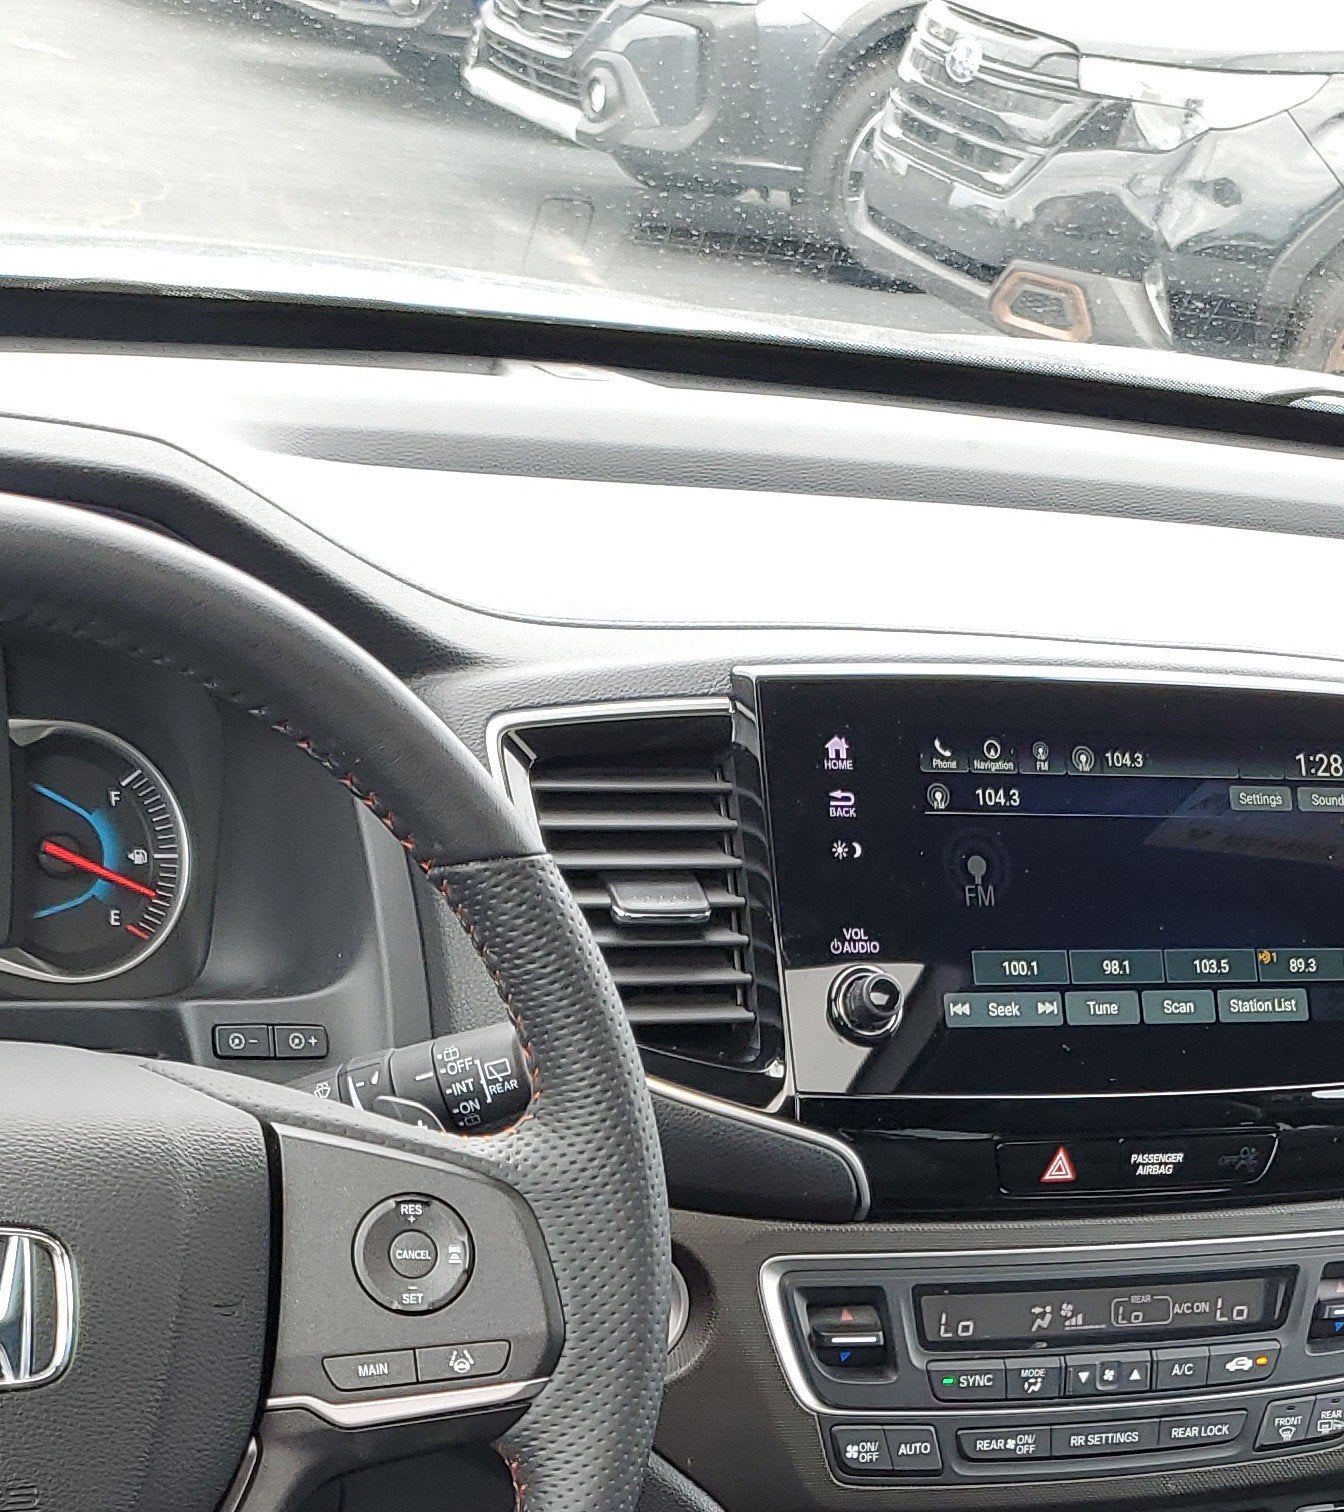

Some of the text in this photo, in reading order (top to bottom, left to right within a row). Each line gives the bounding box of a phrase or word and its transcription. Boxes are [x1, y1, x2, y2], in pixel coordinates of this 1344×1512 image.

[824, 760, 853, 771] HOME
[932, 758, 957, 769] Phone
[974, 759, 1014, 771] Navigation
[1037, 761, 1048, 771] FM
[1105, 752, 1144, 768] 104.3
[1295, 753, 1344, 777] 1:28
[110, 791, 121, 807] F
[976, 788, 1020, 806] 104.3
[1239, 791, 1283, 808] Settings
[1311, 794, 1344, 806] Sound
[829, 807, 856, 818] BACK
[965, 885, 995, 907] FM
[110, 910, 121, 926] E
[843, 928, 868, 940] VOL
[843, 941, 880, 953] AUDIO
[1002, 961, 1038, 976] 100.1
[1102, 960, 1130, 975] 98.1
[1193, 959, 1229, 974] 103.5
[1289, 958, 1317, 973] 89.3
[988, 1002, 1021, 1016] Seek
[1087, 1001, 1119, 1015] Tune
[1163, 1000, 1195, 1013] Scan
[1230, 998, 1297, 1013] Station List
[447, 1057, 473, 1075] OFF
[452, 1078, 474, 1096] INT
[489, 1079, 518, 1095] REAR
[460, 1098, 481, 1114] ON
[1131, 1152, 1184, 1164] PASSENGER
[1136, 1164, 1174, 1176] AIRBAG
[400, 1204, 423, 1215] RES
[396, 1250, 431, 1260] CANCEL
[402, 1293, 423, 1304] SET
[1174, 1301, 1210, 1314] A/C ON
[358, 1363, 389, 1377] MAIN
[1020, 1368, 1046, 1378] MODE
[1172, 1363, 1194, 1376] A/C
[959, 1374, 994, 1388] SYNC
[1274, 1415, 1303, 1427] FRONT
[1321, 1409, 1343, 1420] REAR
[1171, 1424, 1230, 1439] REAR LOCK
[976, 1439, 1005, 1451] REAR
[1016, 1434, 1036, 1445] ON/
[1070, 1431, 1139, 1447] RR SETTINGS
[859, 1441, 879, 1452] ON/
[898, 1443, 931, 1456] AUTO
[1016, 1444, 1037, 1455] OFF
[859, 1452, 880, 1463] OFF
